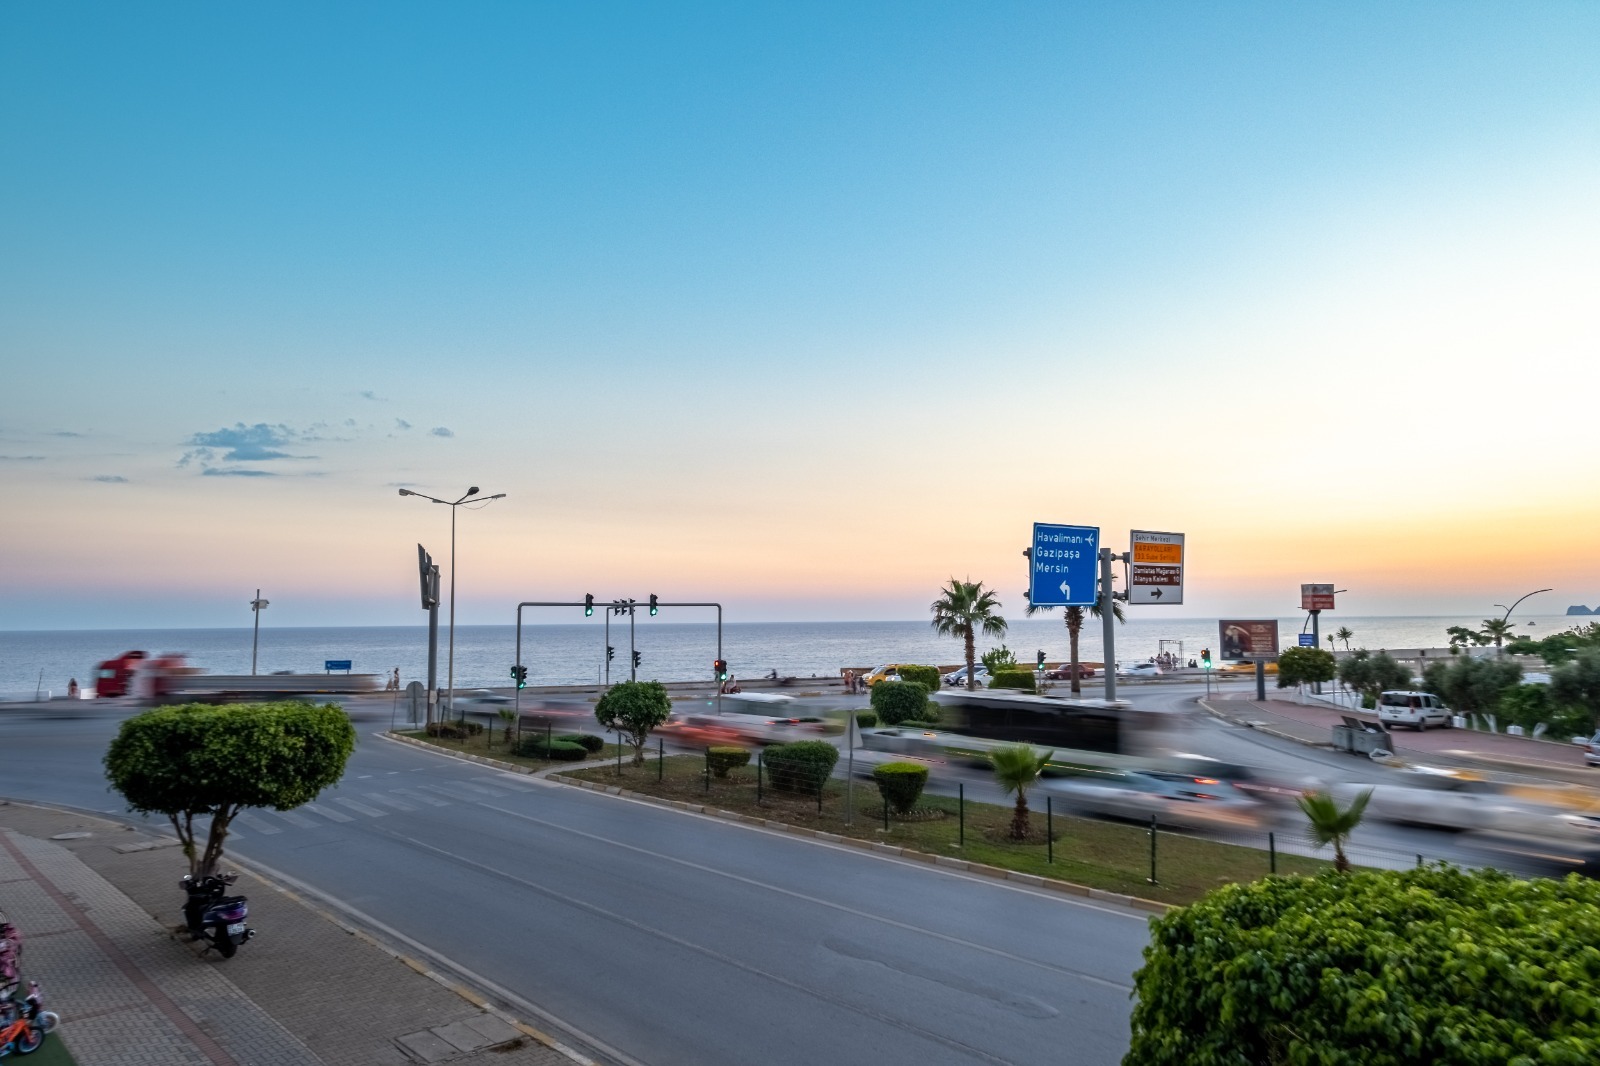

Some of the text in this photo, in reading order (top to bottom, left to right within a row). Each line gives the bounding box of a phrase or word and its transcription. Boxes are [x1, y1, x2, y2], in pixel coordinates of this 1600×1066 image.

[1037, 532, 1083, 544] Havalimanı
[1036, 546, 1080, 560] Gazipaşa
[1036, 562, 1069, 573] Mersin
